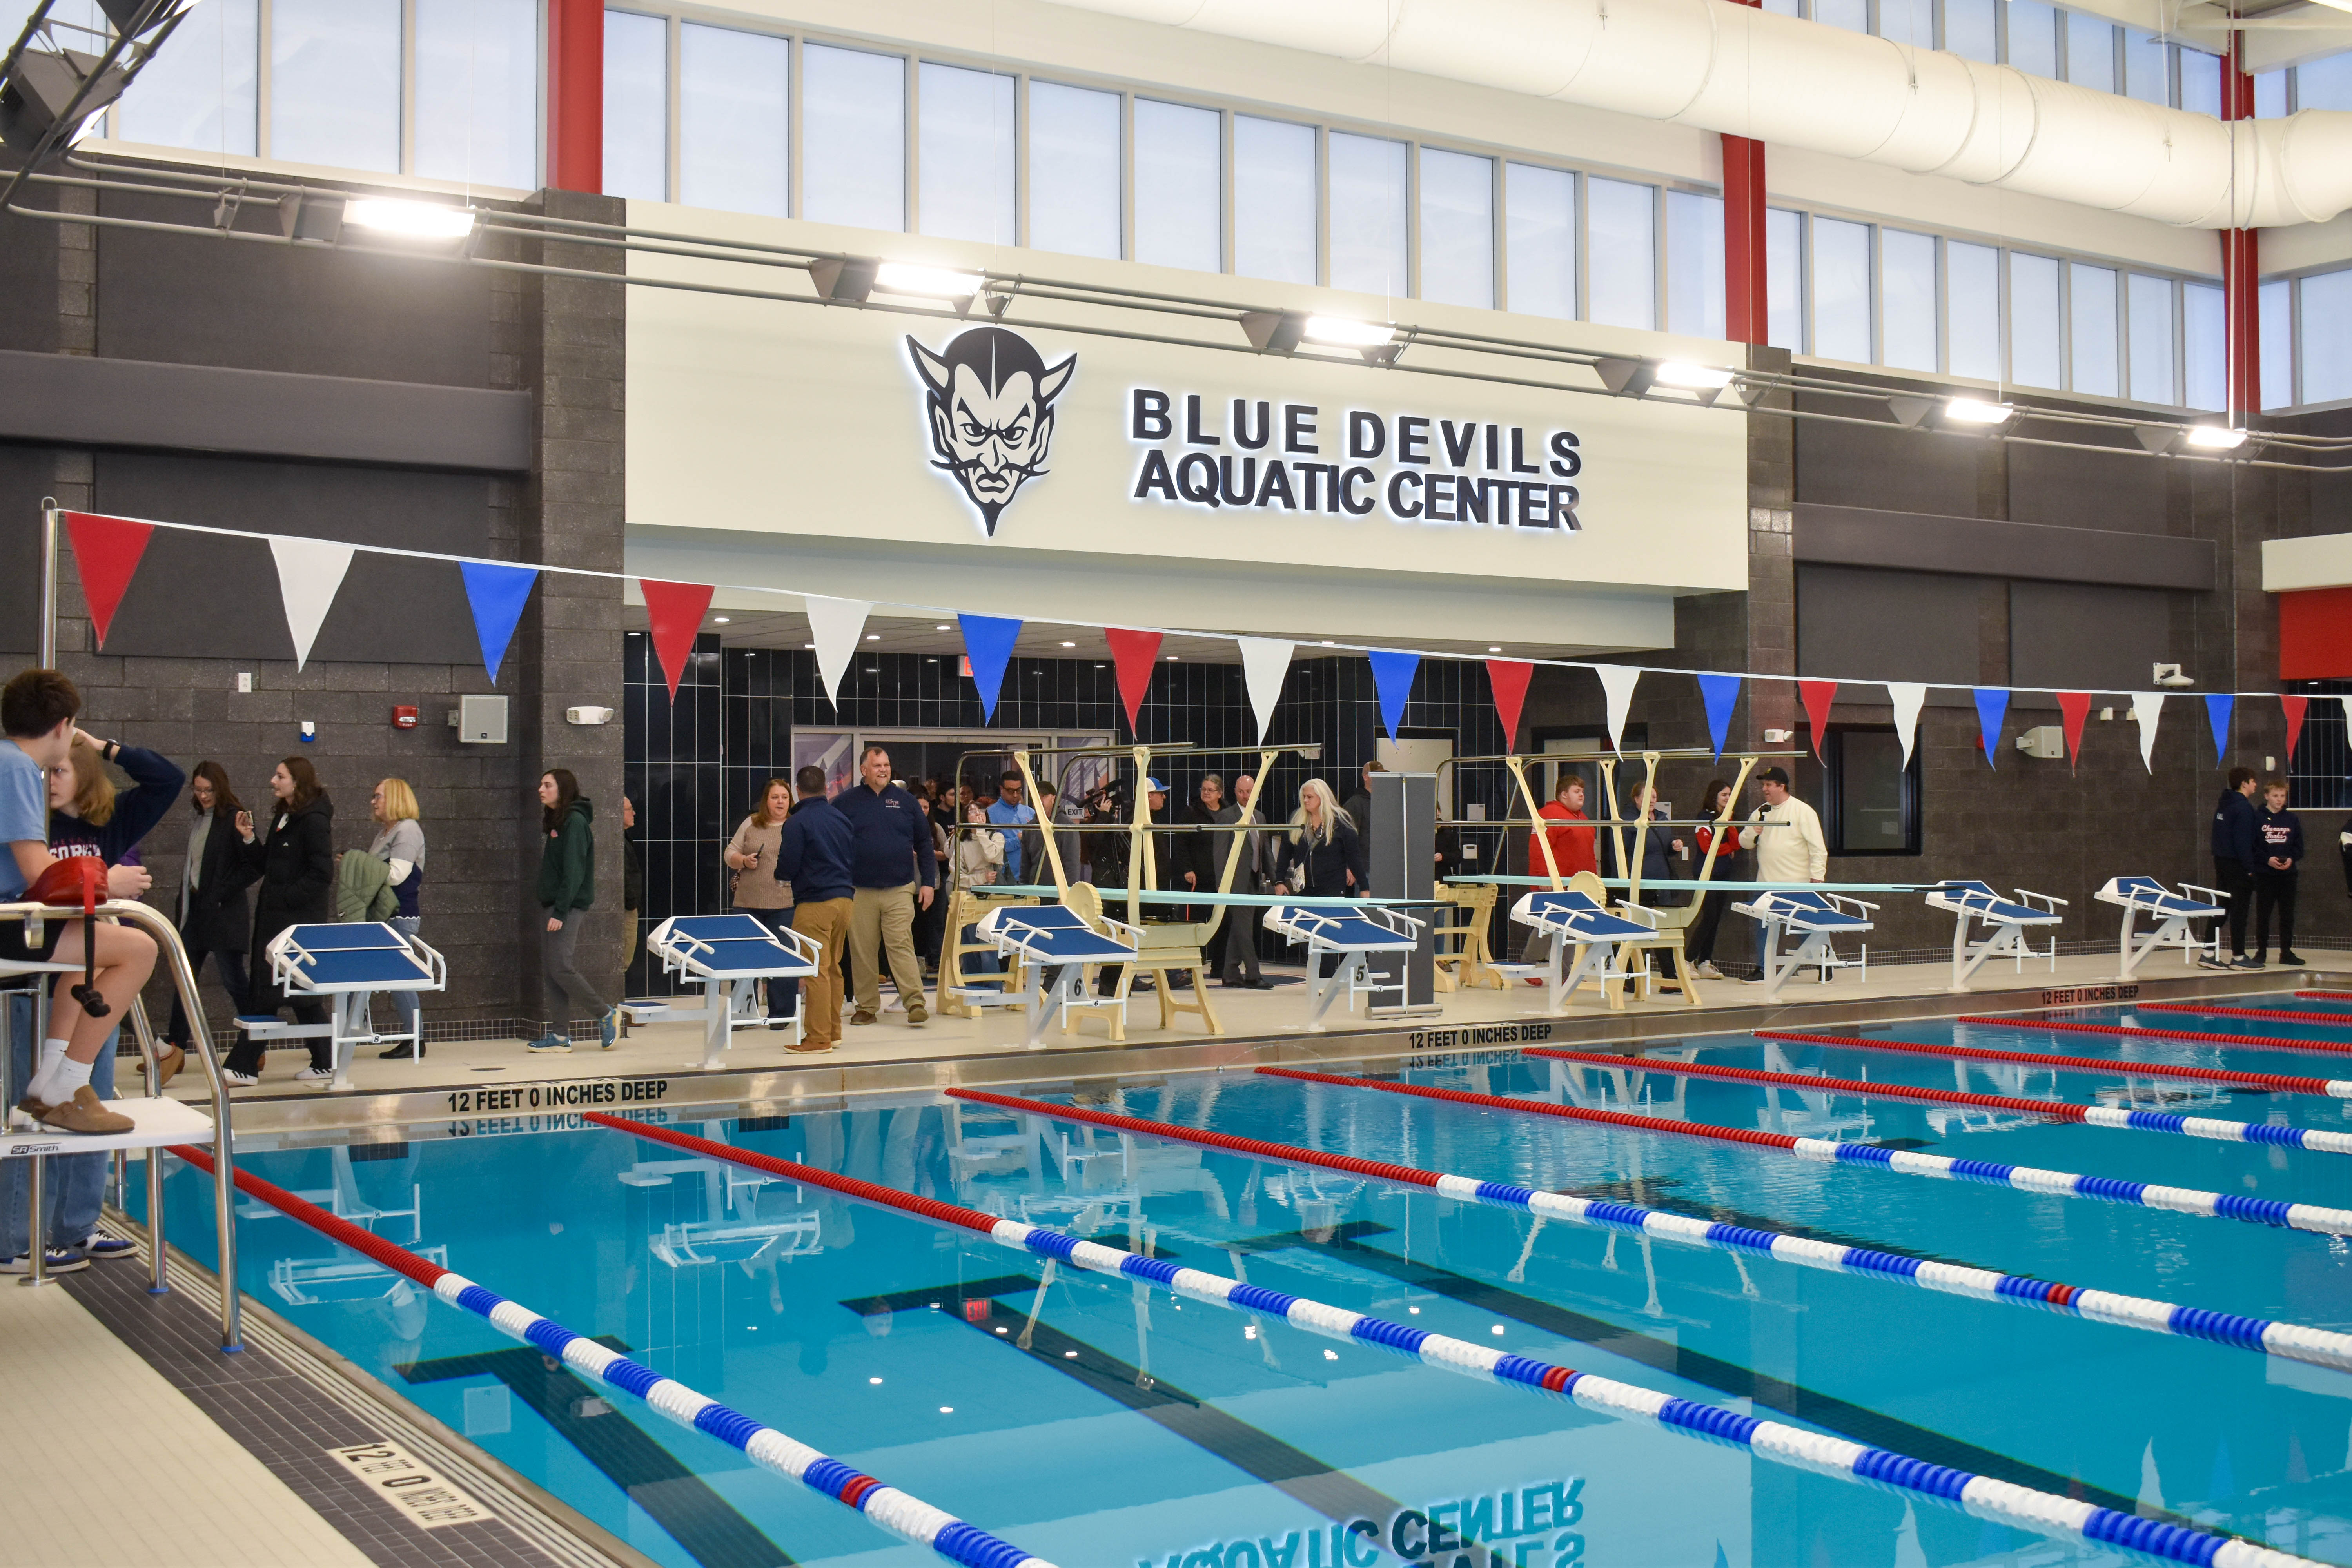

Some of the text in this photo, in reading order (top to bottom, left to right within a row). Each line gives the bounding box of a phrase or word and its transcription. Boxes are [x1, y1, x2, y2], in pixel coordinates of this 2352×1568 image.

[1133, 389, 1581, 477] BLUE DEVILS
[1134, 449, 1582, 531] AQUATIC CENTER
[2261, 824, 2291, 834] Chenango
[1356, 965, 1365, 982] 5
[1074, 978, 1082, 996] 6
[2042, 985, 2138, 1004] 12 FEET 0 INCHES DEEP
[746, 994, 753, 1013] 7
[1409, 1033, 1423, 1049] 12
[1428, 1030, 1457, 1047] FEET
[1462, 1029, 1468, 1045] 0
[1473, 1026, 1517, 1044] INCHES
[1522, 1024, 1551, 1040] DEEP
[449, 1093, 470, 1112] 12
[477, 1089, 523, 1110] FEET
[530, 1088, 539, 1107] 0
[547, 1083, 615, 1106] INCHES
[622, 1080, 667, 1101] DEEP
[340, 1443, 396, 1462] 12
[359, 1459, 415, 1474] FEET
[382, 1475, 432, 1487] 0
[417, 1504, 479, 1521] DEEP
